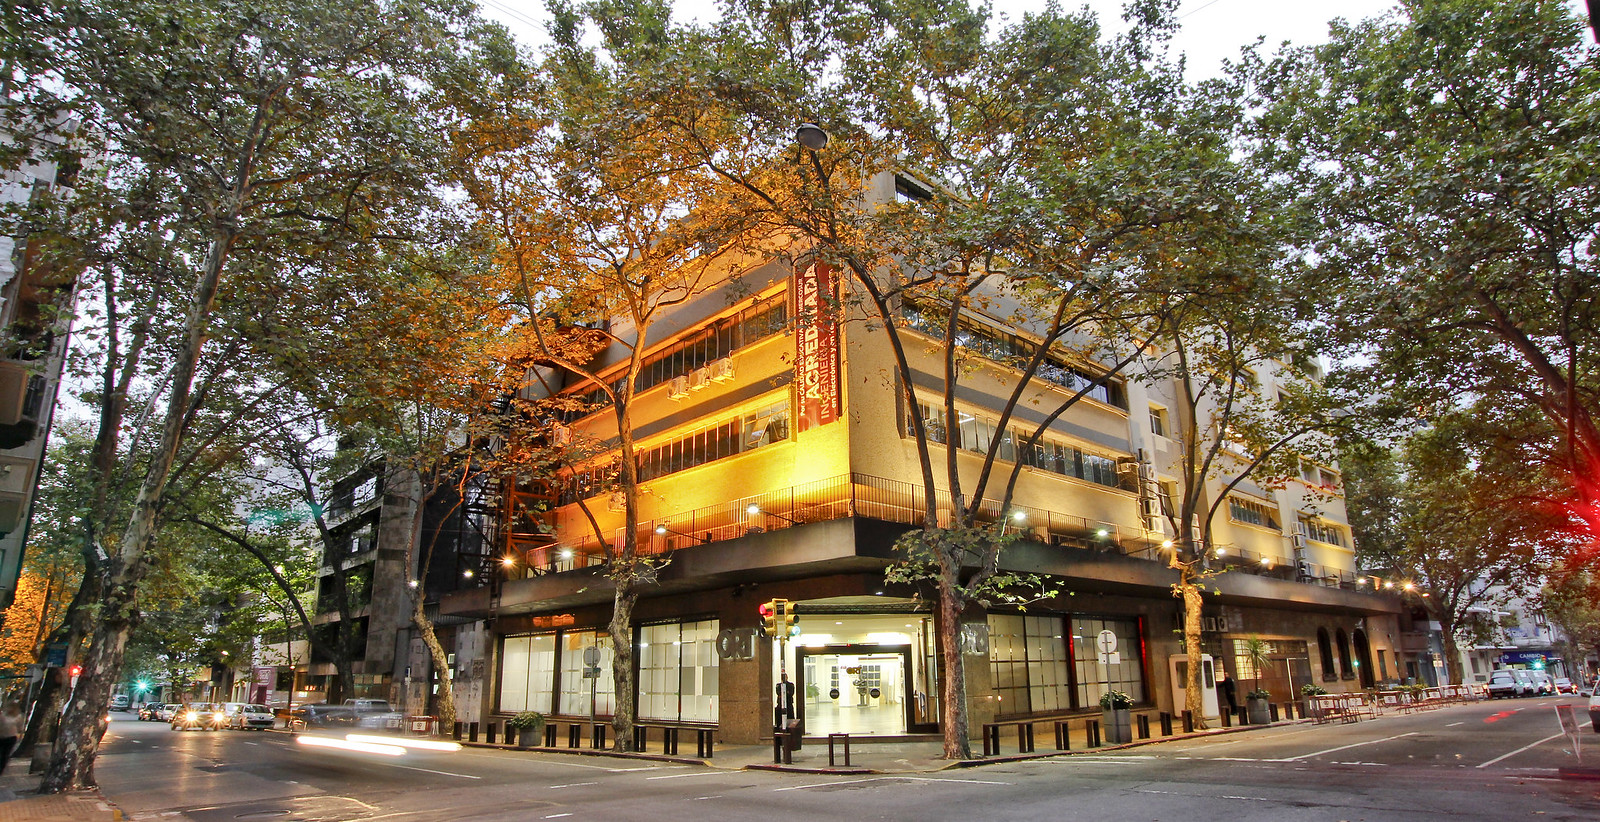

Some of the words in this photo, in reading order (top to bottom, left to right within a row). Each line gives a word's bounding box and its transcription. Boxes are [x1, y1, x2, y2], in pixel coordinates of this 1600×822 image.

[829, 354, 837, 397] Electrónica
[800, 396, 806, 404] su
[831, 398, 837, 408] en
[716, 628, 758, 660] ORT
